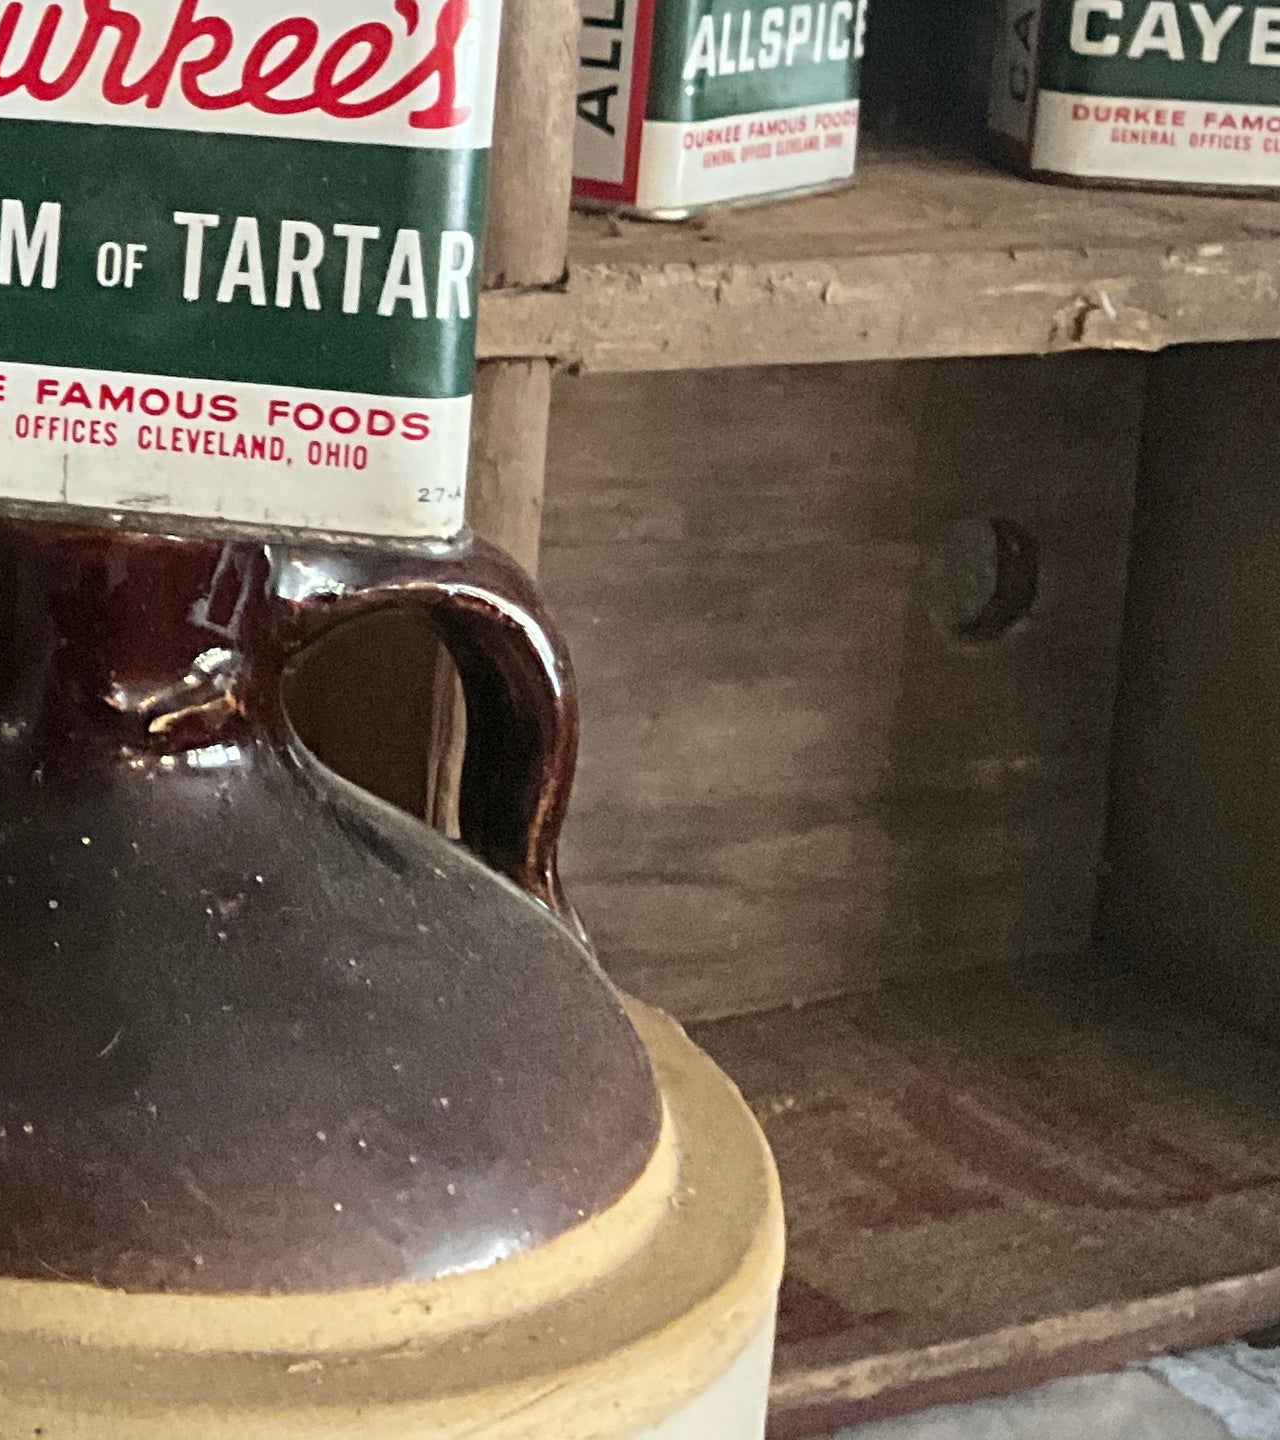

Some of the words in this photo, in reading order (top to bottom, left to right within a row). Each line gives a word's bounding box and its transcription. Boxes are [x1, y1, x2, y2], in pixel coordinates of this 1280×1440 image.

[683, 124, 741, 150] DURKEE
[748, 115, 808, 139] FAMOUS
[1071, 103, 1186, 127] DURKEE
[1111, 127, 1176, 147] GENERAL
[1189, 132, 1251, 152] OFFICES
[96, 241, 148, 288] OF
[173, 211, 475, 319] TARTAR
[36, 378, 238, 423] FAMOUS
[268, 400, 432, 441] FOODS
[14, 414, 119, 447] OFFICES
[139, 426, 294, 466] CLEVELAND,
[307, 444, 368, 471] OHIO
